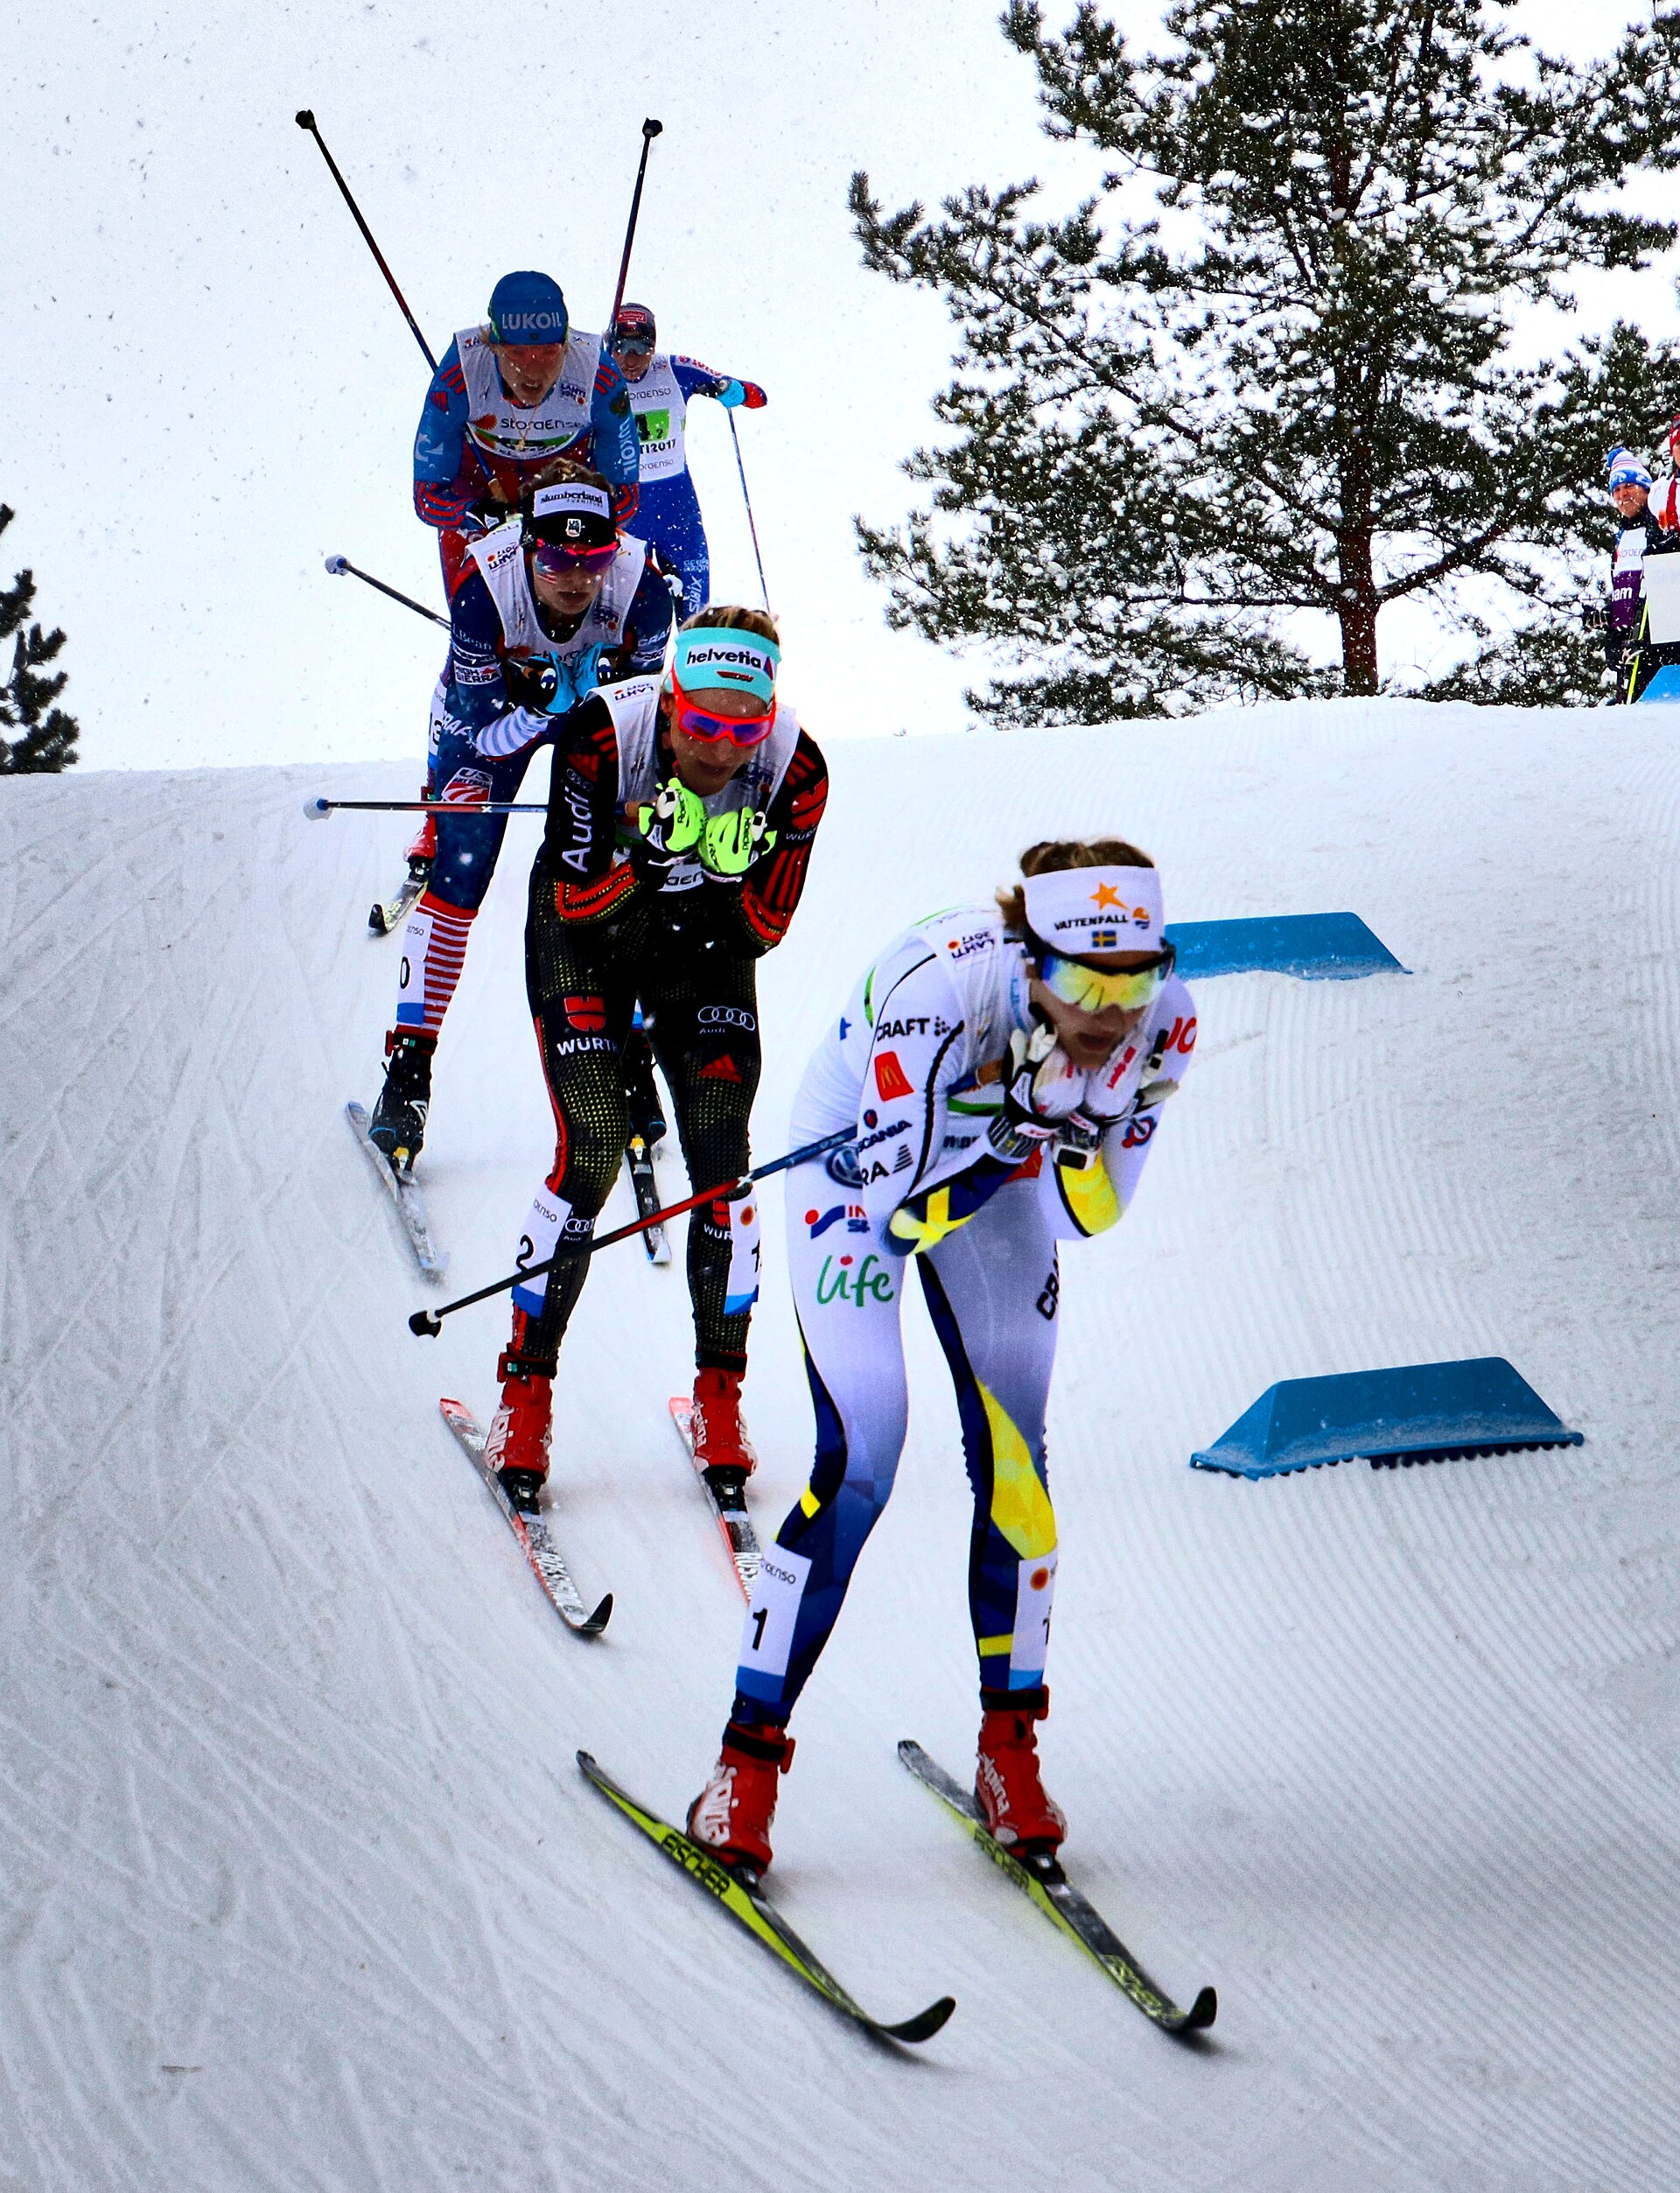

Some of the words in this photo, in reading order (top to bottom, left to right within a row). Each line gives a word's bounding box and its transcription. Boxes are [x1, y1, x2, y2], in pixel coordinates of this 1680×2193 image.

[501, 311, 563, 330] LUKOIL
[629, 387, 672, 401] oraenso
[618, 416, 637, 476] LUKOIL
[640, 438, 676, 455] TI2017
[639, 458, 676, 471] oraenso
[541, 490, 604, 505] slumberland
[638, 625, 672, 647] CRAF
[687, 648, 762, 669] helvetia
[562, 786, 592, 872] Audi
[1054, 914, 1129, 930] VATTENFALL
[876, 1018, 930, 1041] CRAFT
[556, 1037, 618, 1056] WÜRT
[752, 1608, 768, 1651] 1
[662, 1833, 731, 1898] FISCHER
